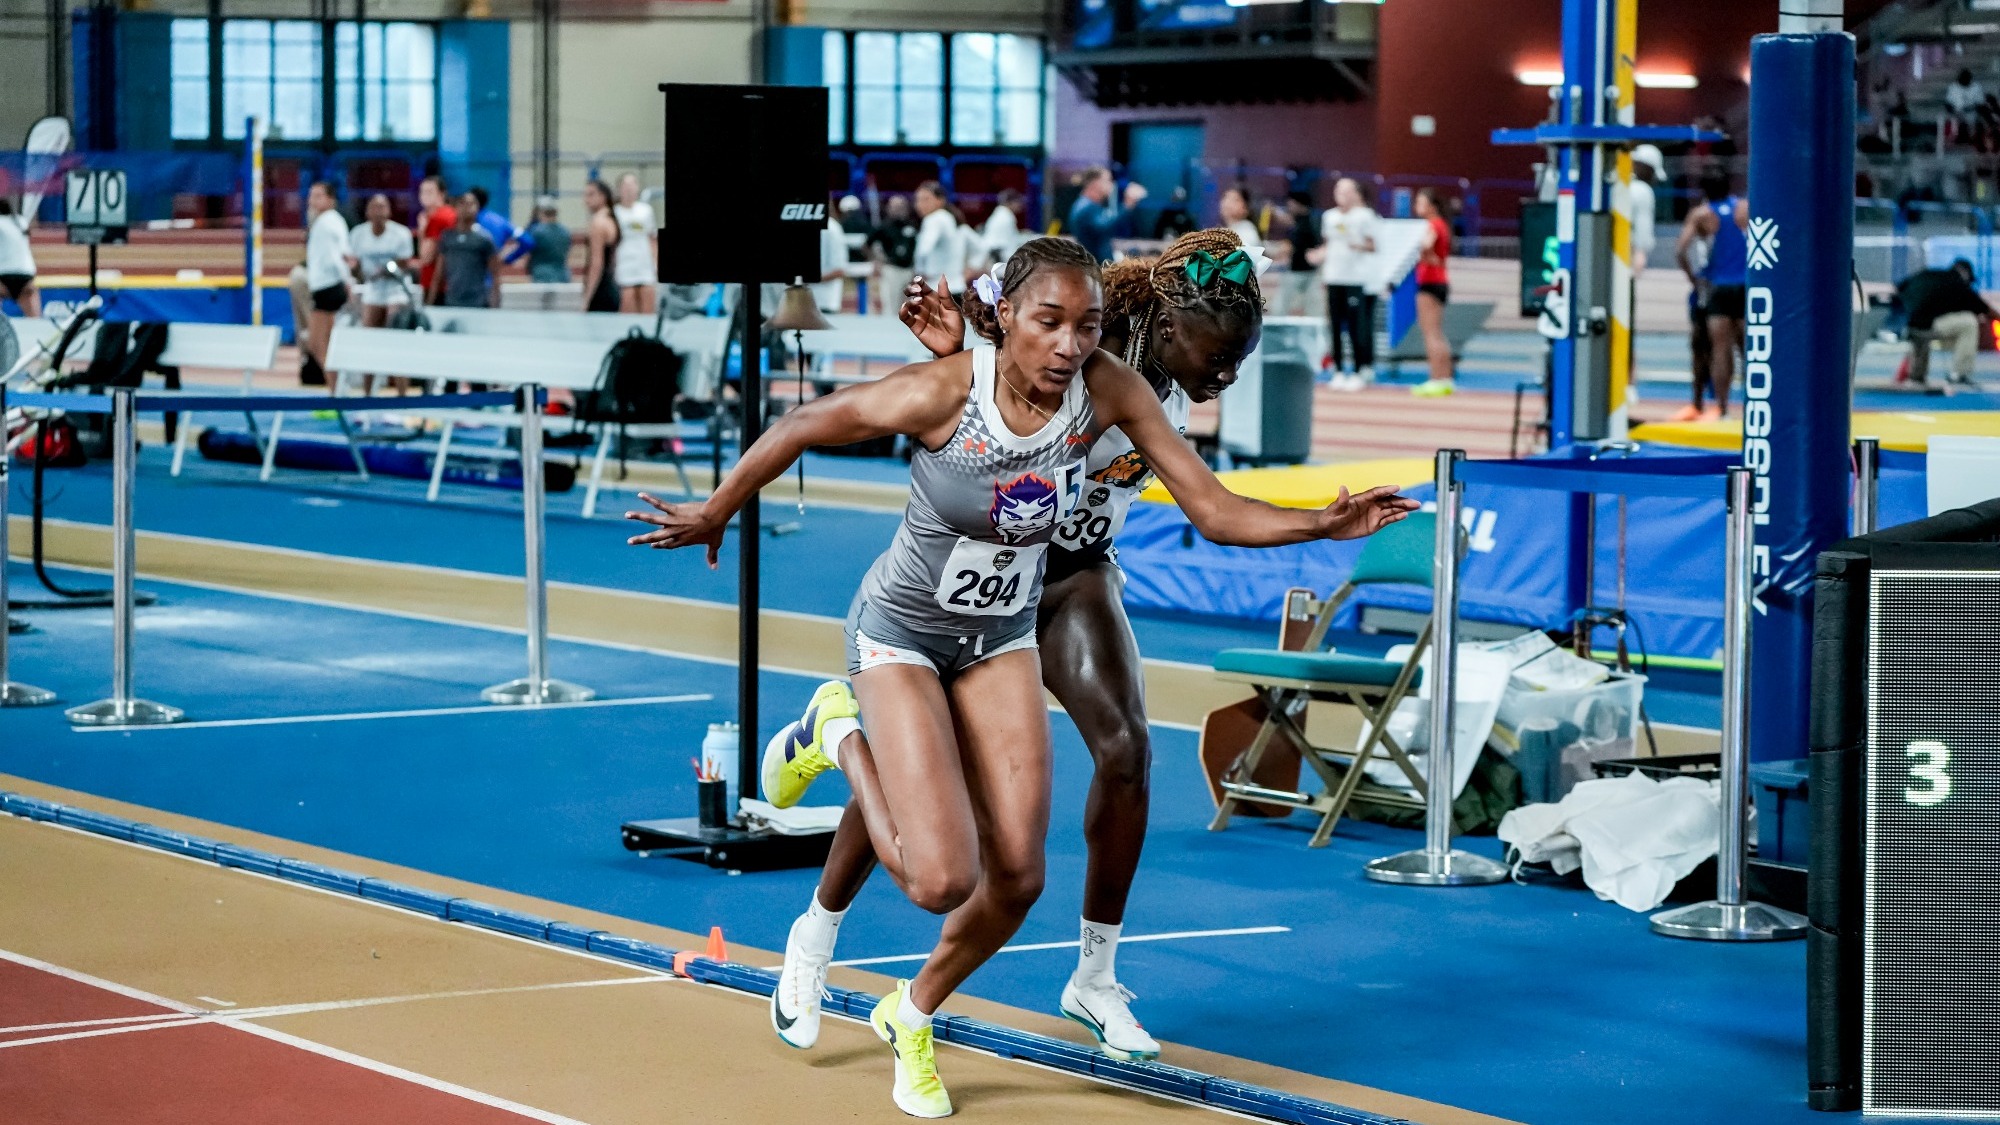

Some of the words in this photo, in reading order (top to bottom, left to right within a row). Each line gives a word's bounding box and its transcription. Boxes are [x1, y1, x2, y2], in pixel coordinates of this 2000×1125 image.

[74, 170, 121, 210] 70
[780, 203, 826, 220] GILL
[1063, 463, 1082, 519] 5
[947, 569, 1021, 609] 294
[1906, 741, 1951, 806] 3
